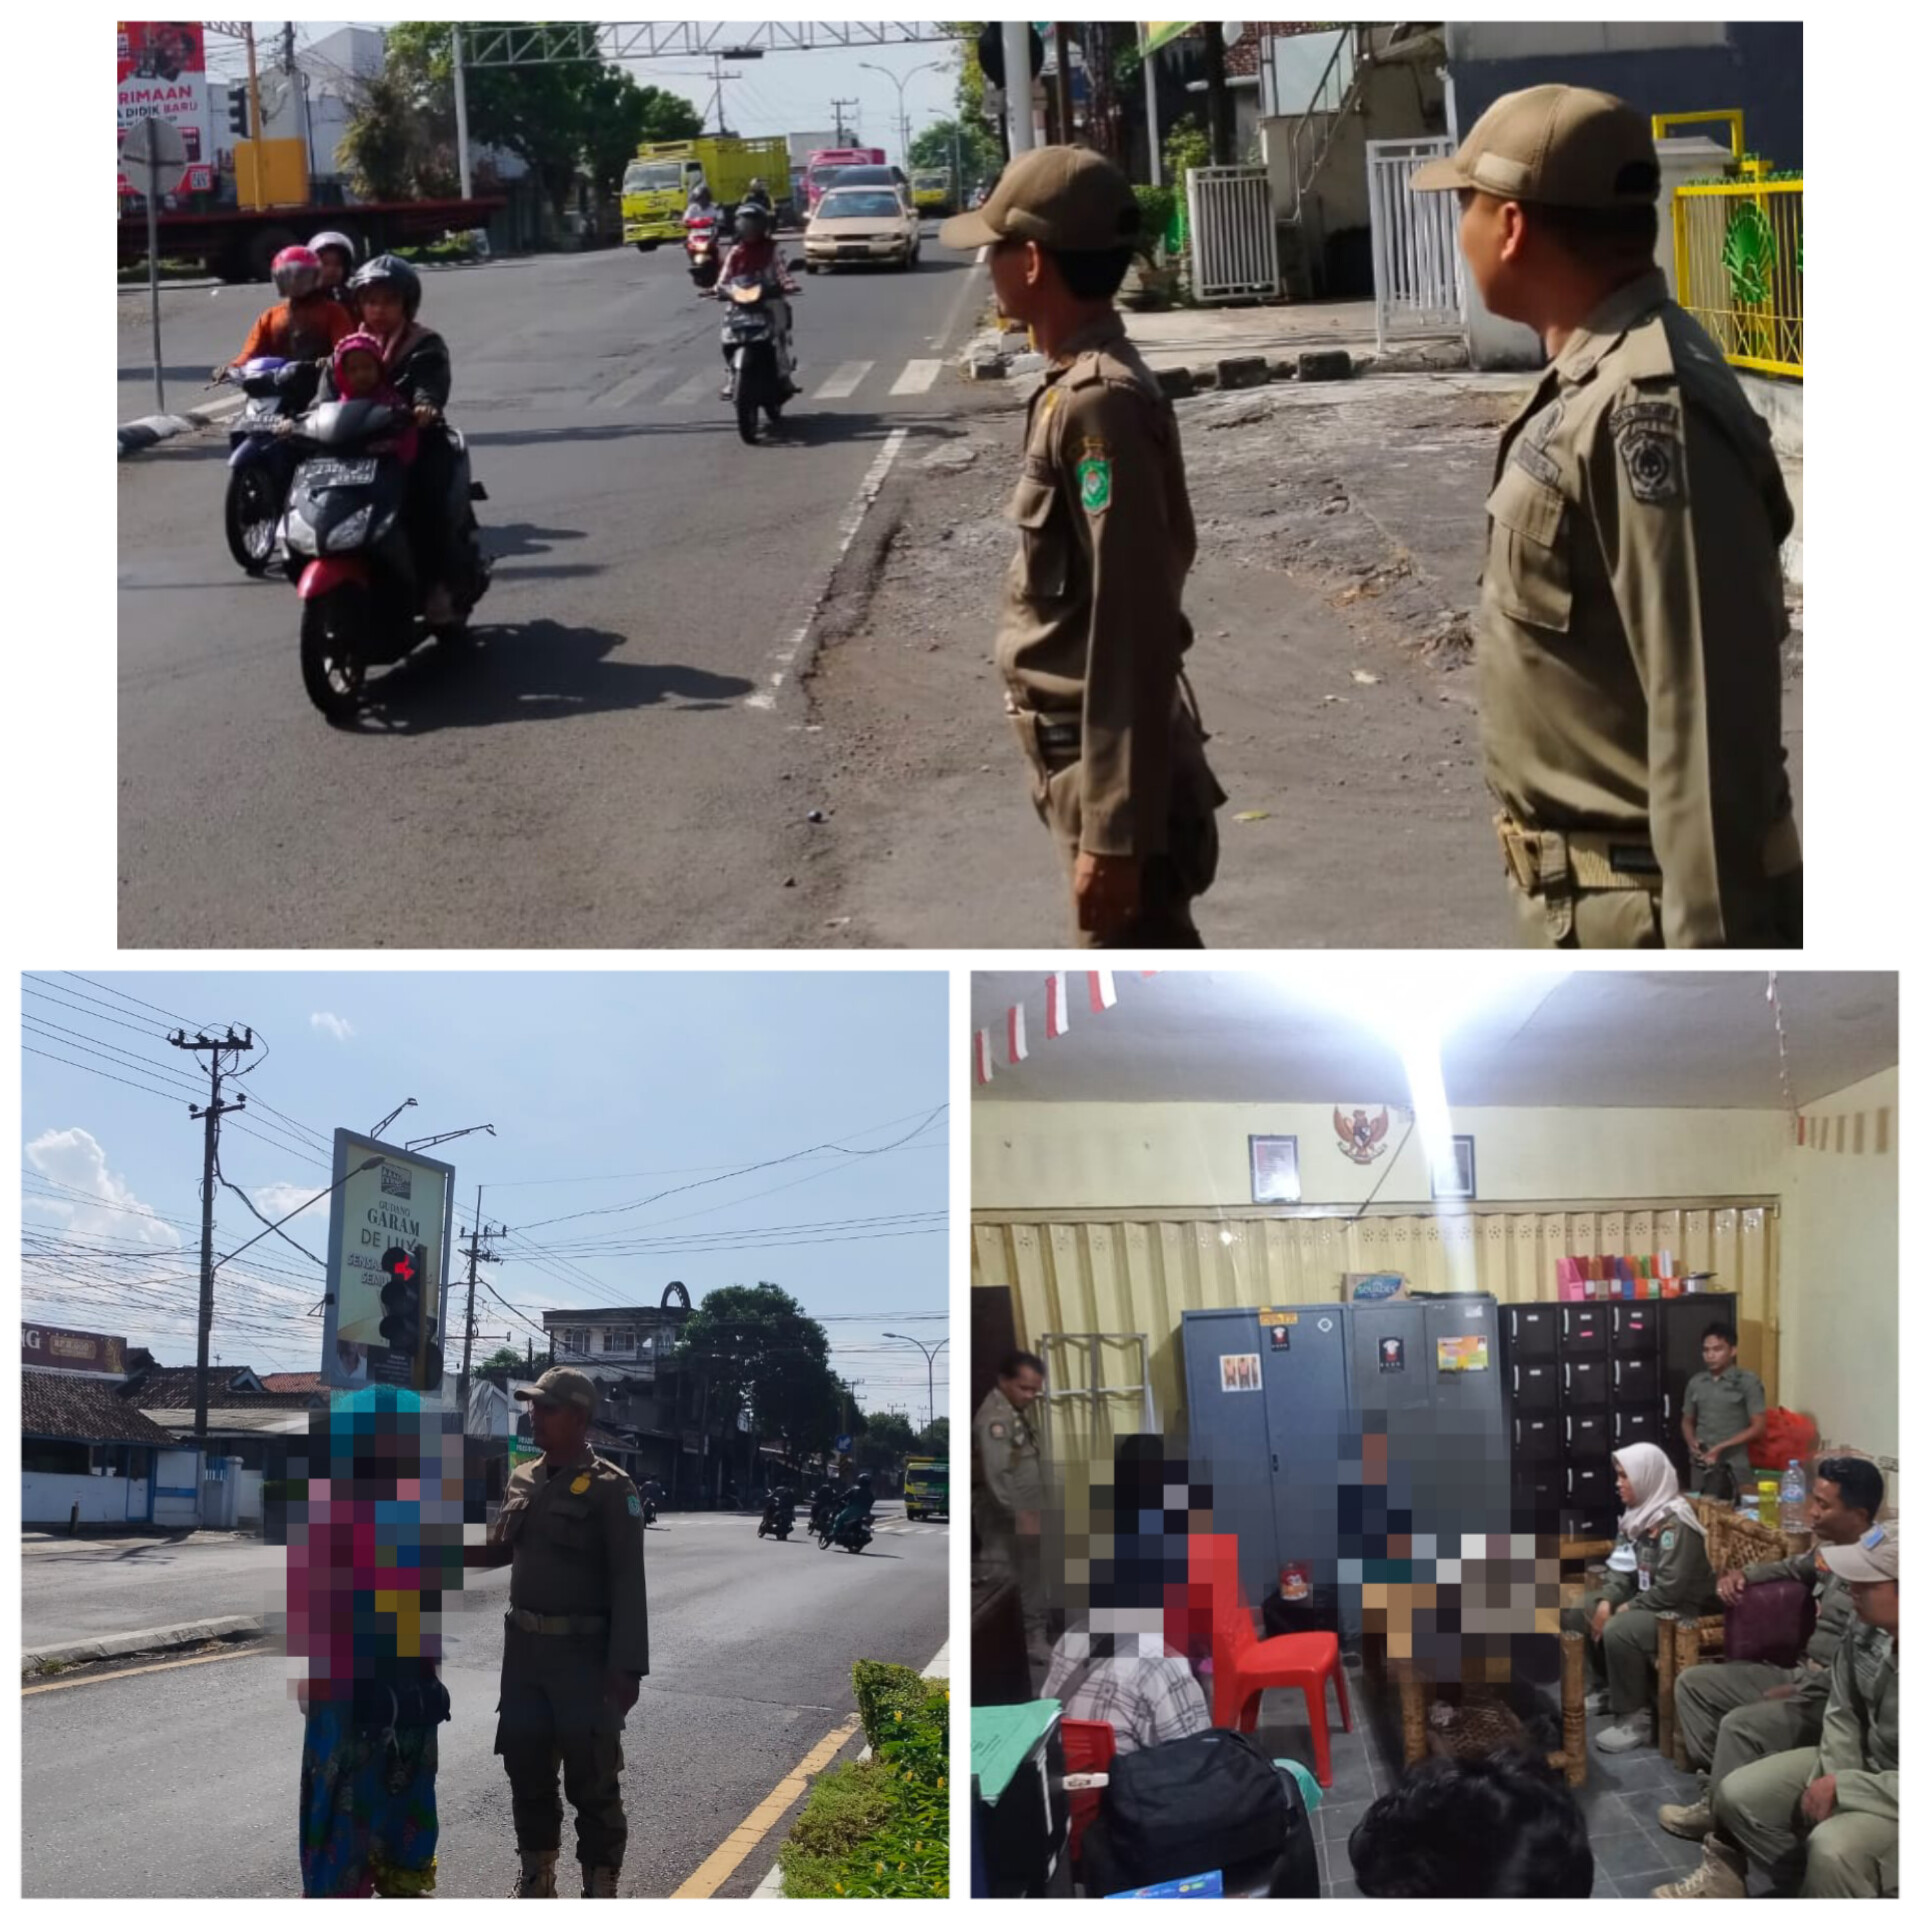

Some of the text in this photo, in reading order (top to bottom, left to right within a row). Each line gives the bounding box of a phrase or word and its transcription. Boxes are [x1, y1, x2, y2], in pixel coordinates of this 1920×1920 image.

[126, 106, 160, 117] DIDIK
[164, 102, 198, 113] BARU
[379, 1201, 410, 1217] GUDANG
[367, 1208, 420, 1237] GARAM
[361, 1228, 381, 1247] DE
